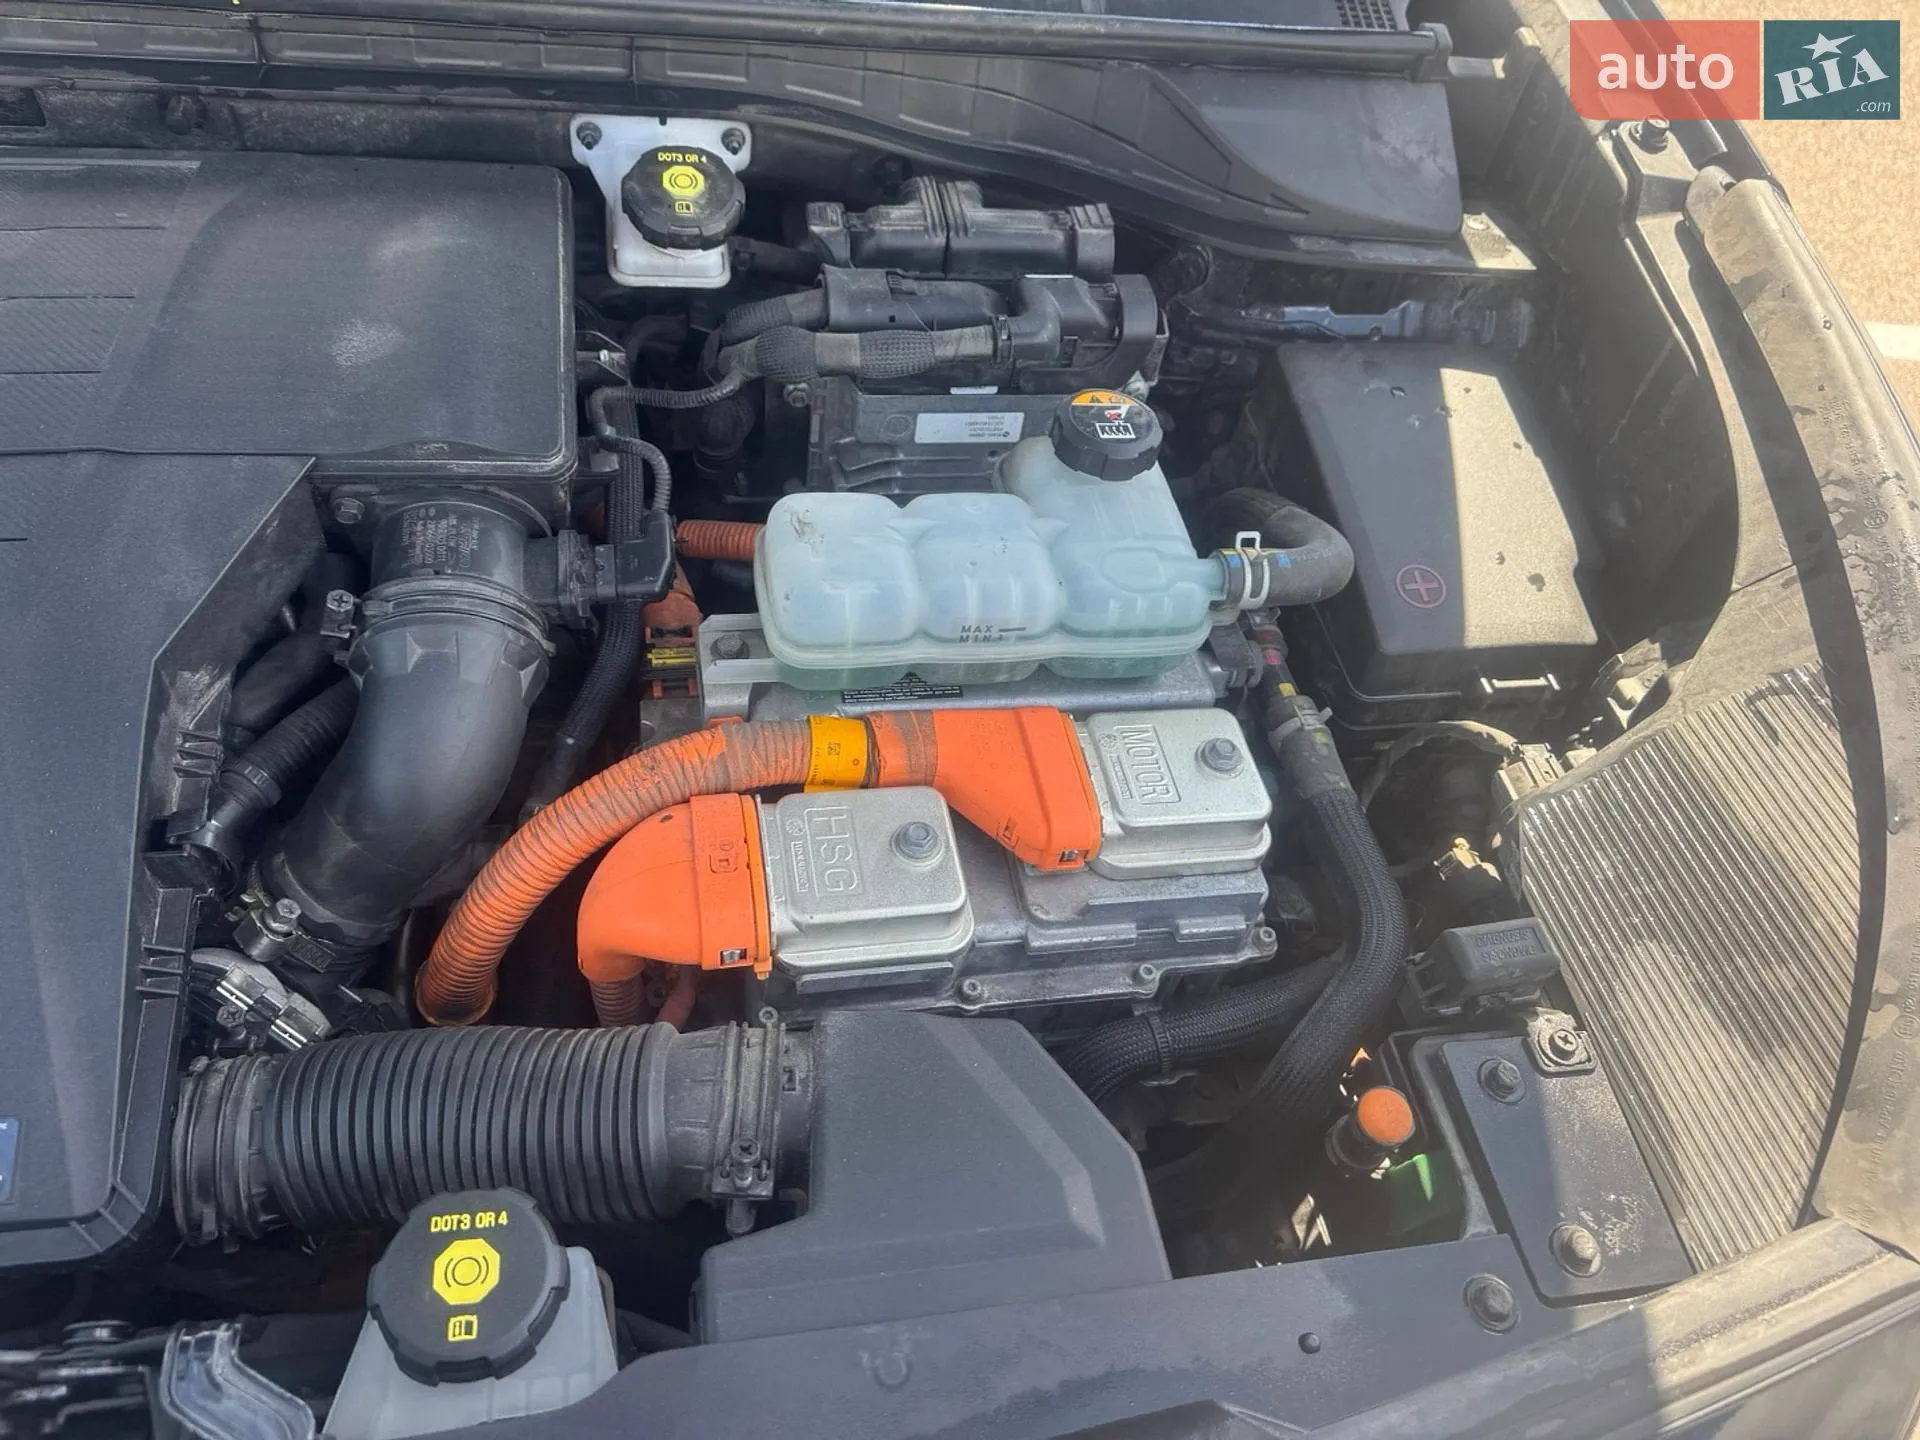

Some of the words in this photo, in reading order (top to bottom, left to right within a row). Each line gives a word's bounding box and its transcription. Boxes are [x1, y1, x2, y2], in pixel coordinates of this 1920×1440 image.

[657, 152, 683, 163] DOT3
[684, 153, 699, 164] OR
[960, 624, 993, 635] MAX
[1119, 726, 1173, 803] MOTOR
[813, 813, 859, 893] HSG
[430, 1213, 471, 1233] DOT3
[475, 1211, 495, 1229] OR
[498, 1210, 509, 1227] 4
